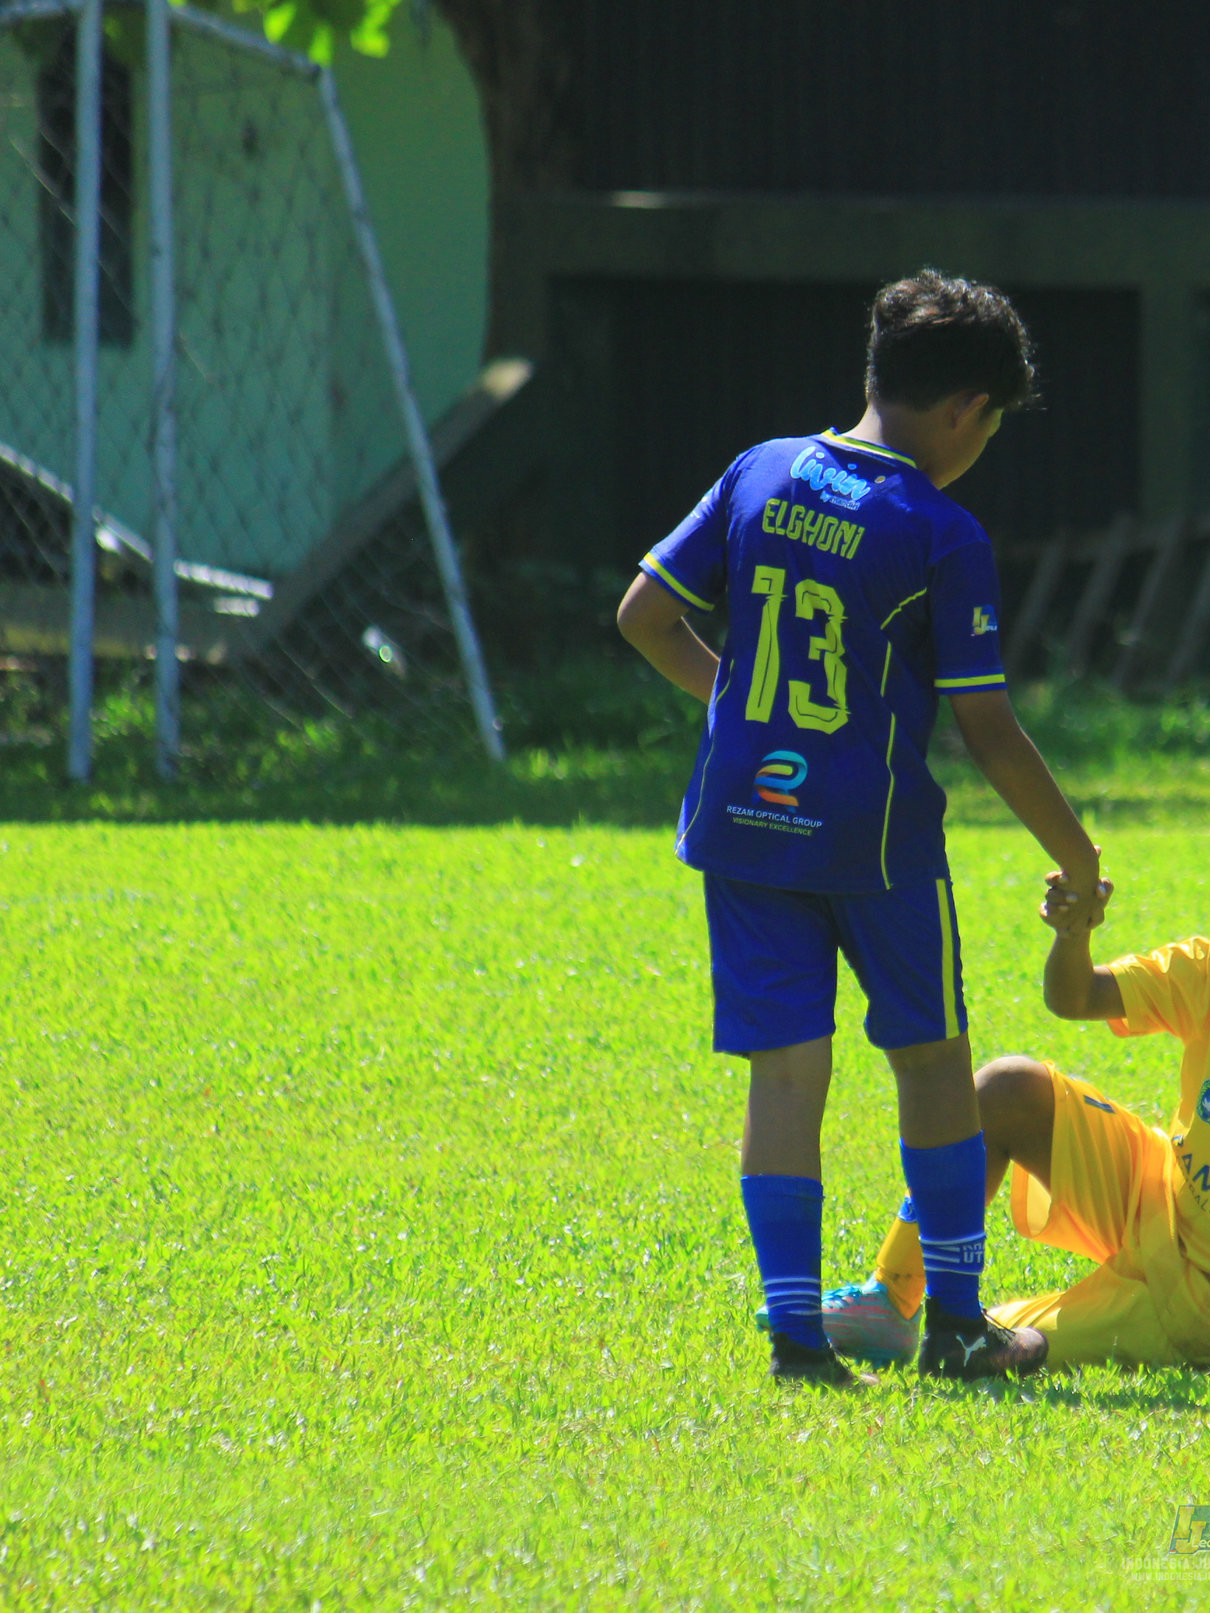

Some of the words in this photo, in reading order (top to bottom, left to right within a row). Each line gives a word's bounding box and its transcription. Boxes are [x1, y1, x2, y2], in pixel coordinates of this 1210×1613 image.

[762, 498, 865, 560] ELGHONI
[745, 565, 850, 735] 13
[726, 805, 754, 817] REZAM
[755, 810, 791, 823] OPTICAL
[792, 816, 823, 828] GROUP
[732, 817, 768, 828] VISIONARY
[769, 822, 812, 836] EXCELLENCE
